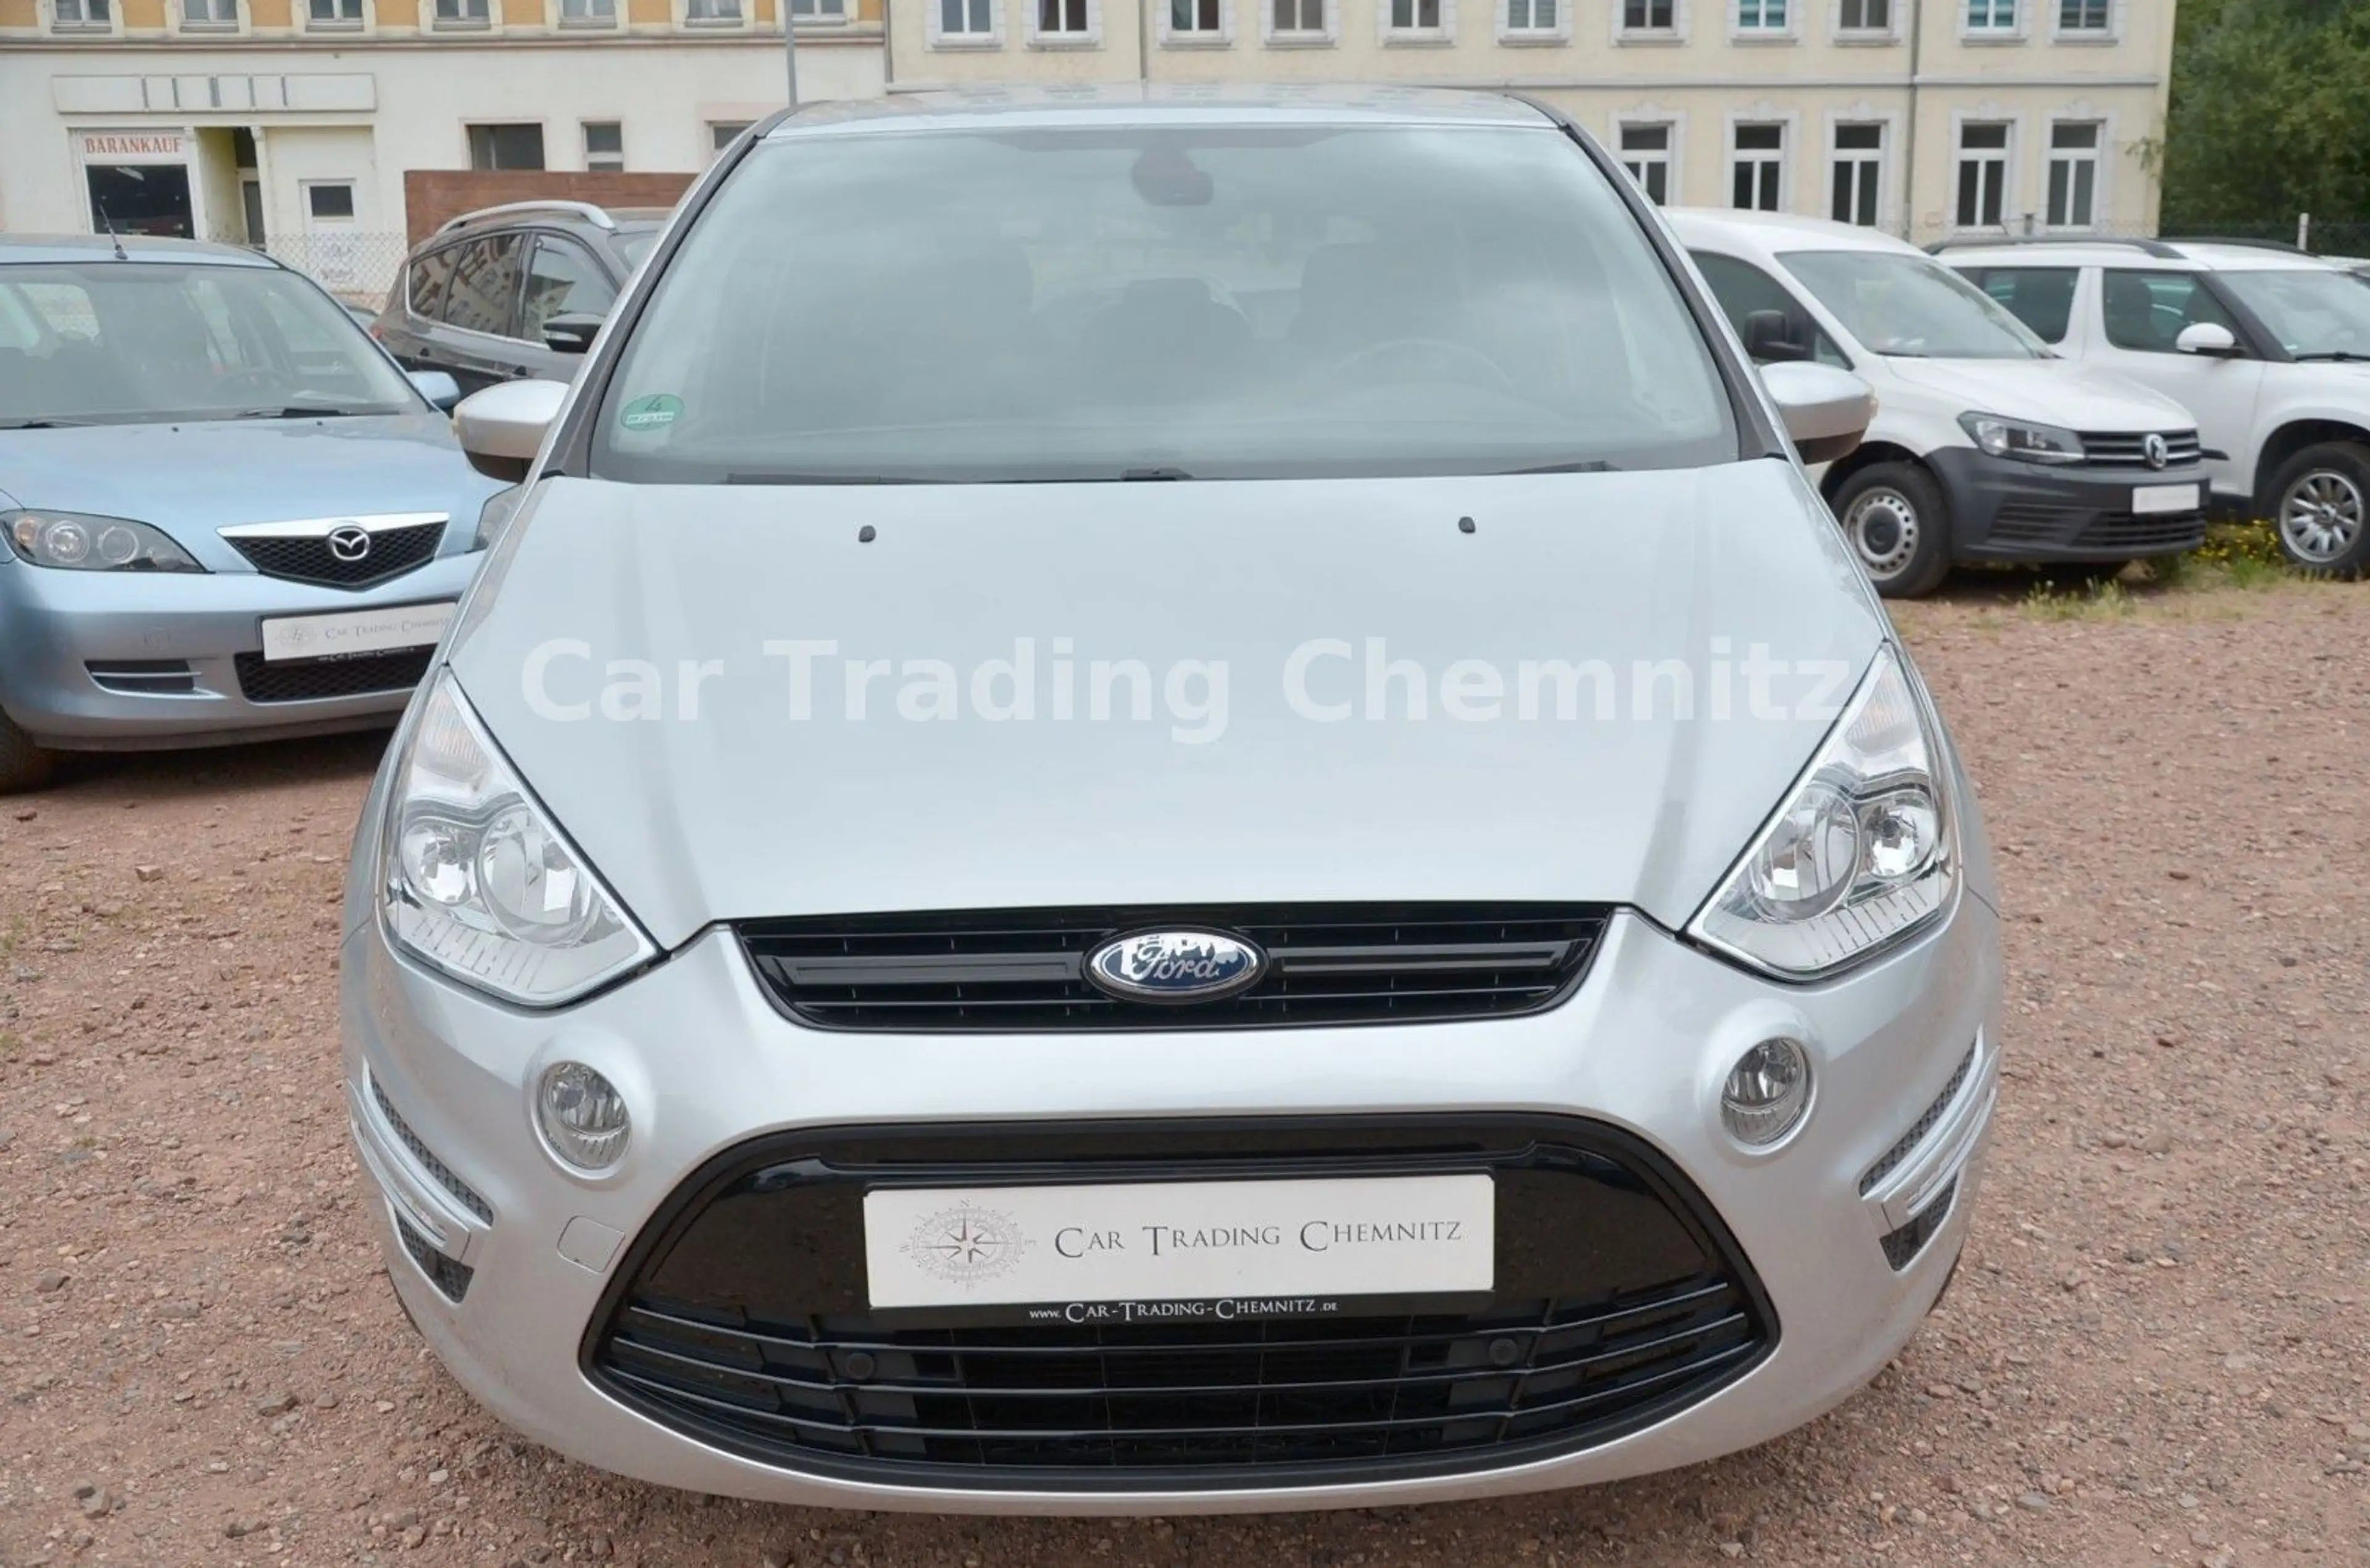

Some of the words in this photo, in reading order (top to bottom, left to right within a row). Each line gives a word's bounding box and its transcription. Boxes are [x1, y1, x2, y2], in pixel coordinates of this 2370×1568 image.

[85, 137, 182, 153] BARANKAUF
[1129, 942, 1220, 982] Ford
[1054, 1227, 1126, 1259] CAR
[1142, 1225, 1281, 1256] TRADING
[1299, 1220, 1462, 1252] CHEMNITZ
